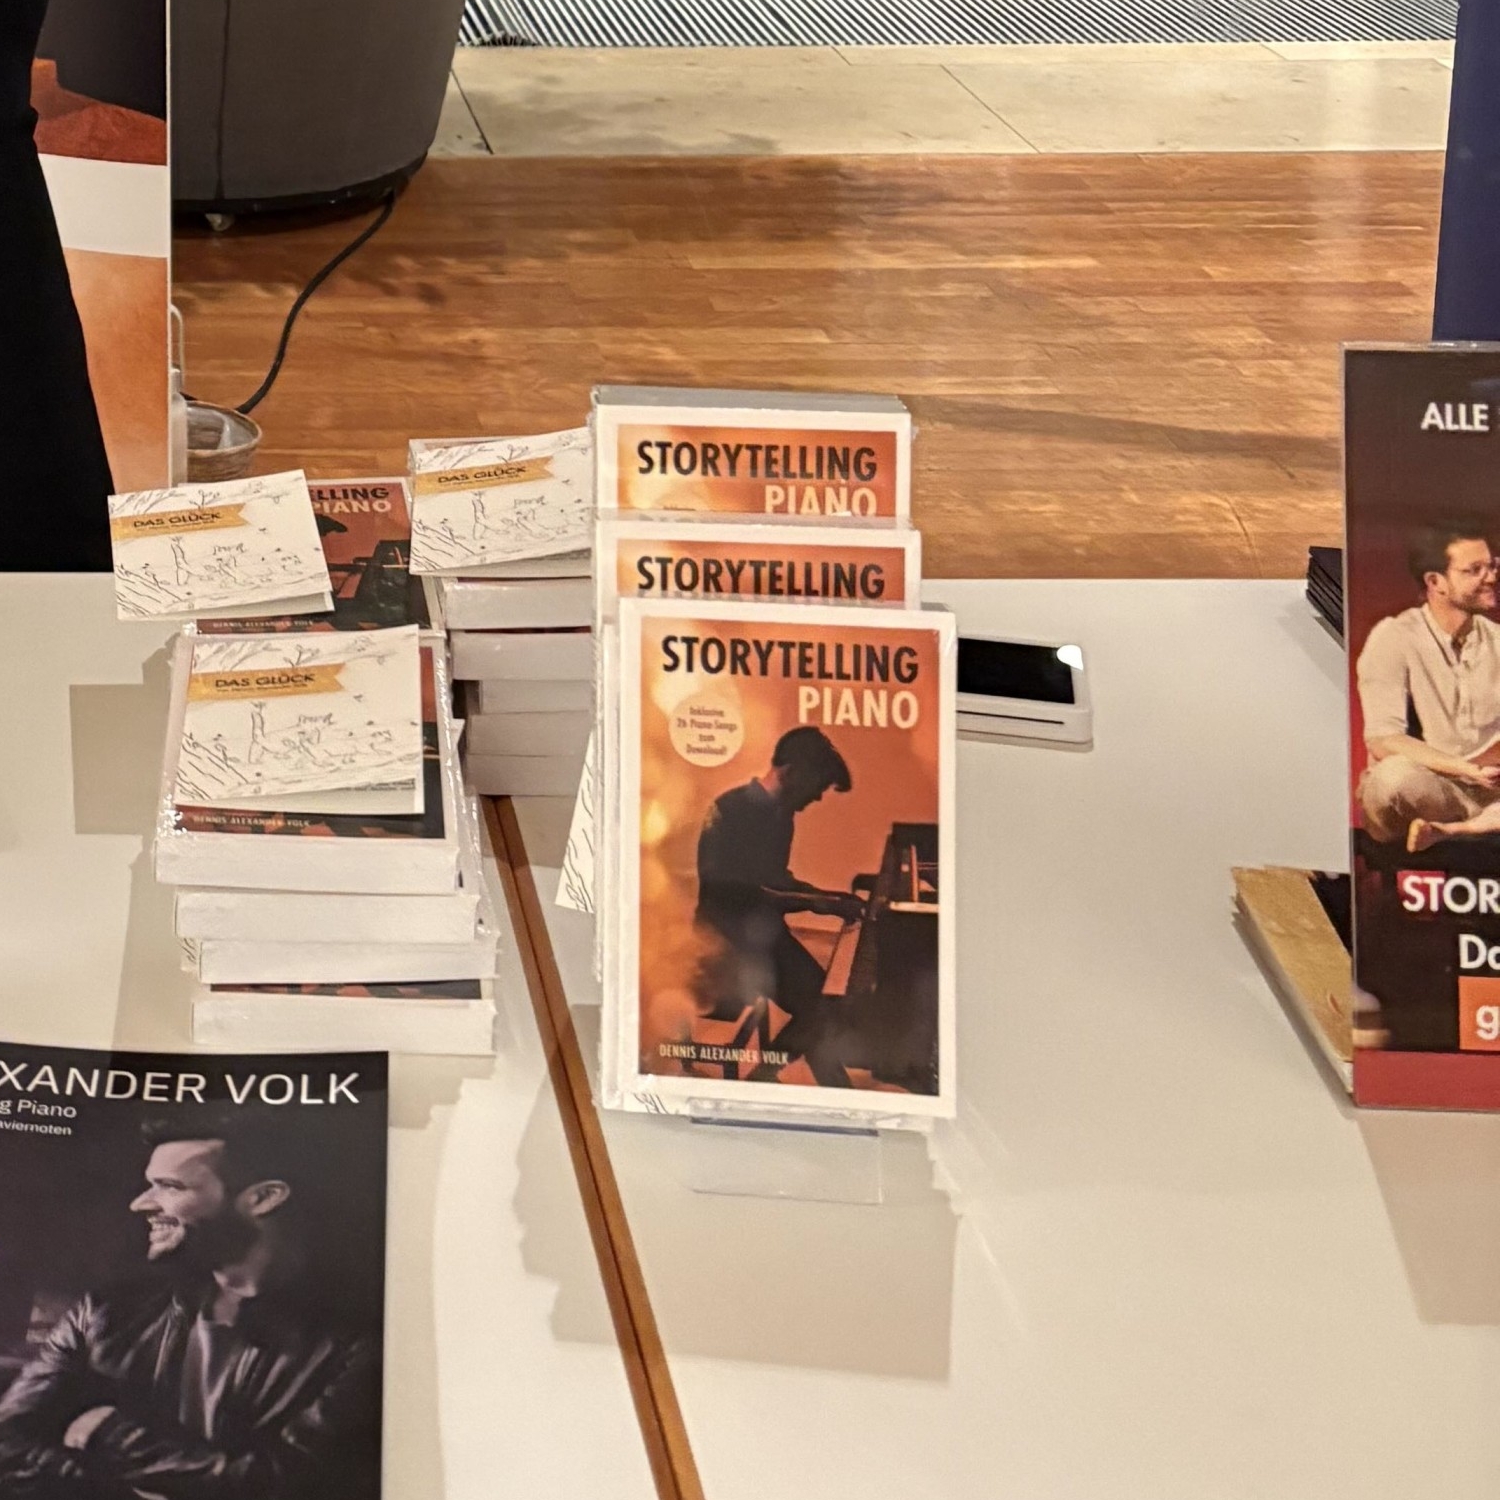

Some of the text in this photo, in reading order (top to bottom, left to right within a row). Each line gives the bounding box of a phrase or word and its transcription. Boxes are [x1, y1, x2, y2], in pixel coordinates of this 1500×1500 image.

[1420, 402, 1490, 431] ALLE
[438, 473, 469, 484] DAS
[473, 465, 527, 480] GLÜCK
[637, 440, 877, 482] STORYTELLING
[764, 484, 877, 517] PIANO
[133, 518, 166, 528] DAS
[168, 511, 222, 525] GLÜCK
[636, 555, 886, 599] STORYTELLING
[662, 634, 919, 684] STORYTELLING
[215, 678, 250, 688] DAS
[255, 672, 316, 686] GLÜCK
[798, 686, 919, 729] PIANO
[659, 1043, 789, 1066] DENNIS ALEXANDER VOLK
[225, 1072, 360, 1105] VOLK
[17, 1098, 78, 1119] Piano
